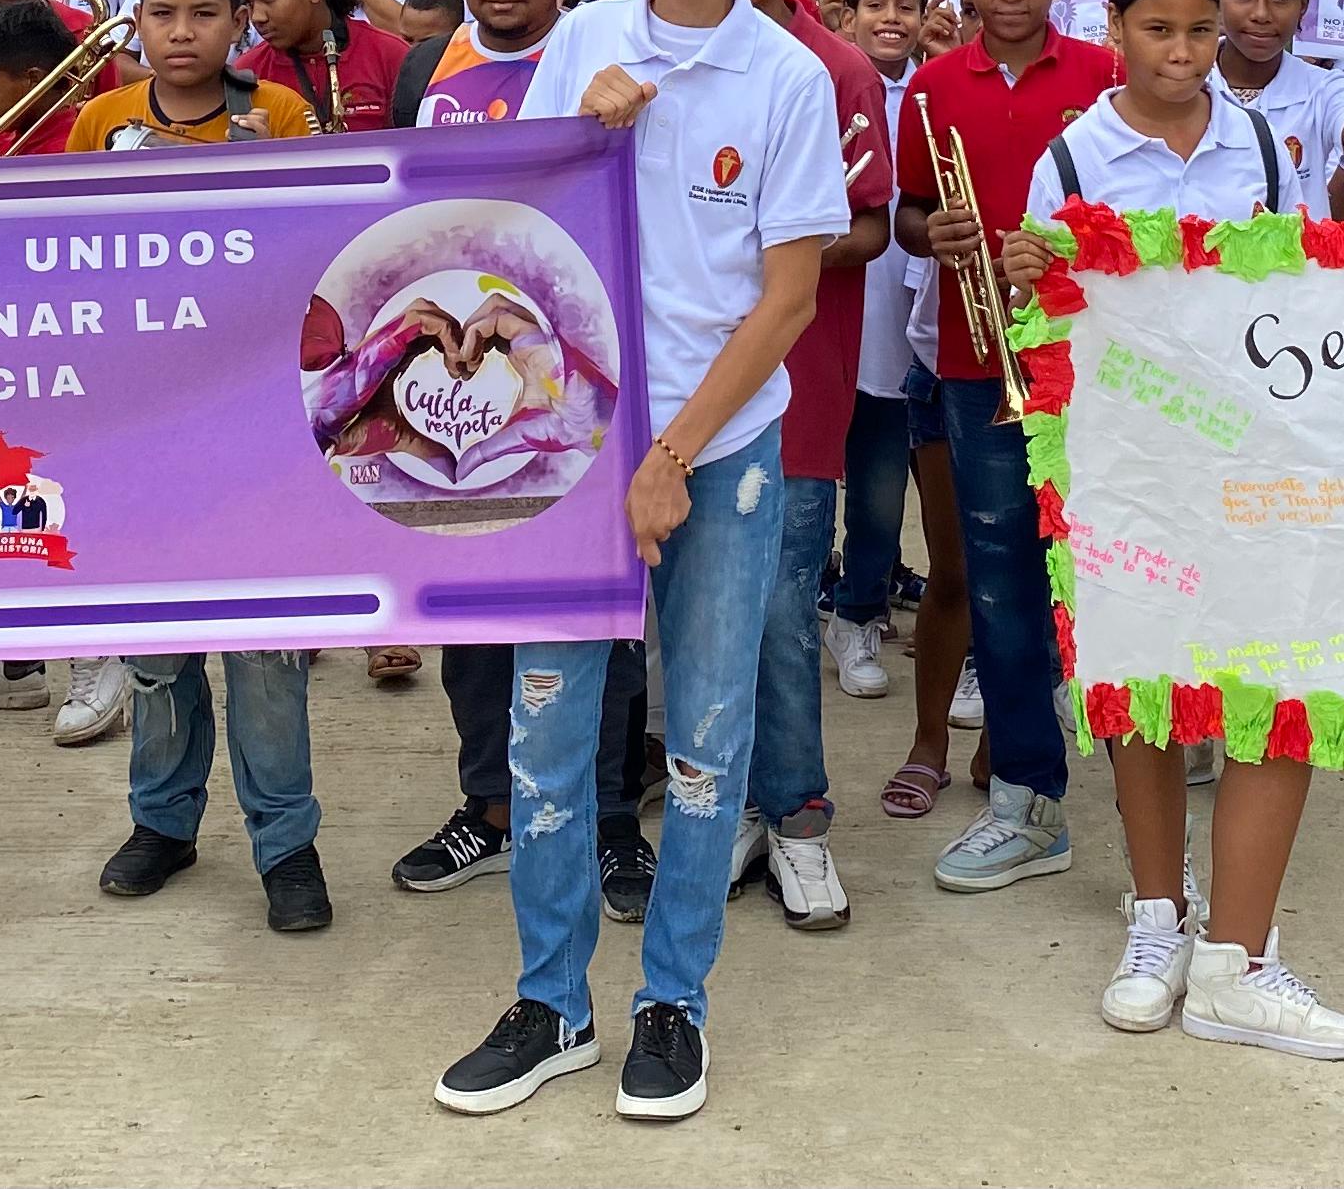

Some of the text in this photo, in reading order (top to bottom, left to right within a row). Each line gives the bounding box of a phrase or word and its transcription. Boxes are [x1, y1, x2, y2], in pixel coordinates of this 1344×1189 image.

[1323, 18, 1341, 26] NO
[24, 229, 256, 272] UNIDOS
[135, 295, 208, 334] LA
[424, 400, 503, 450] respeta
[19, 537, 44, 547] UNA
